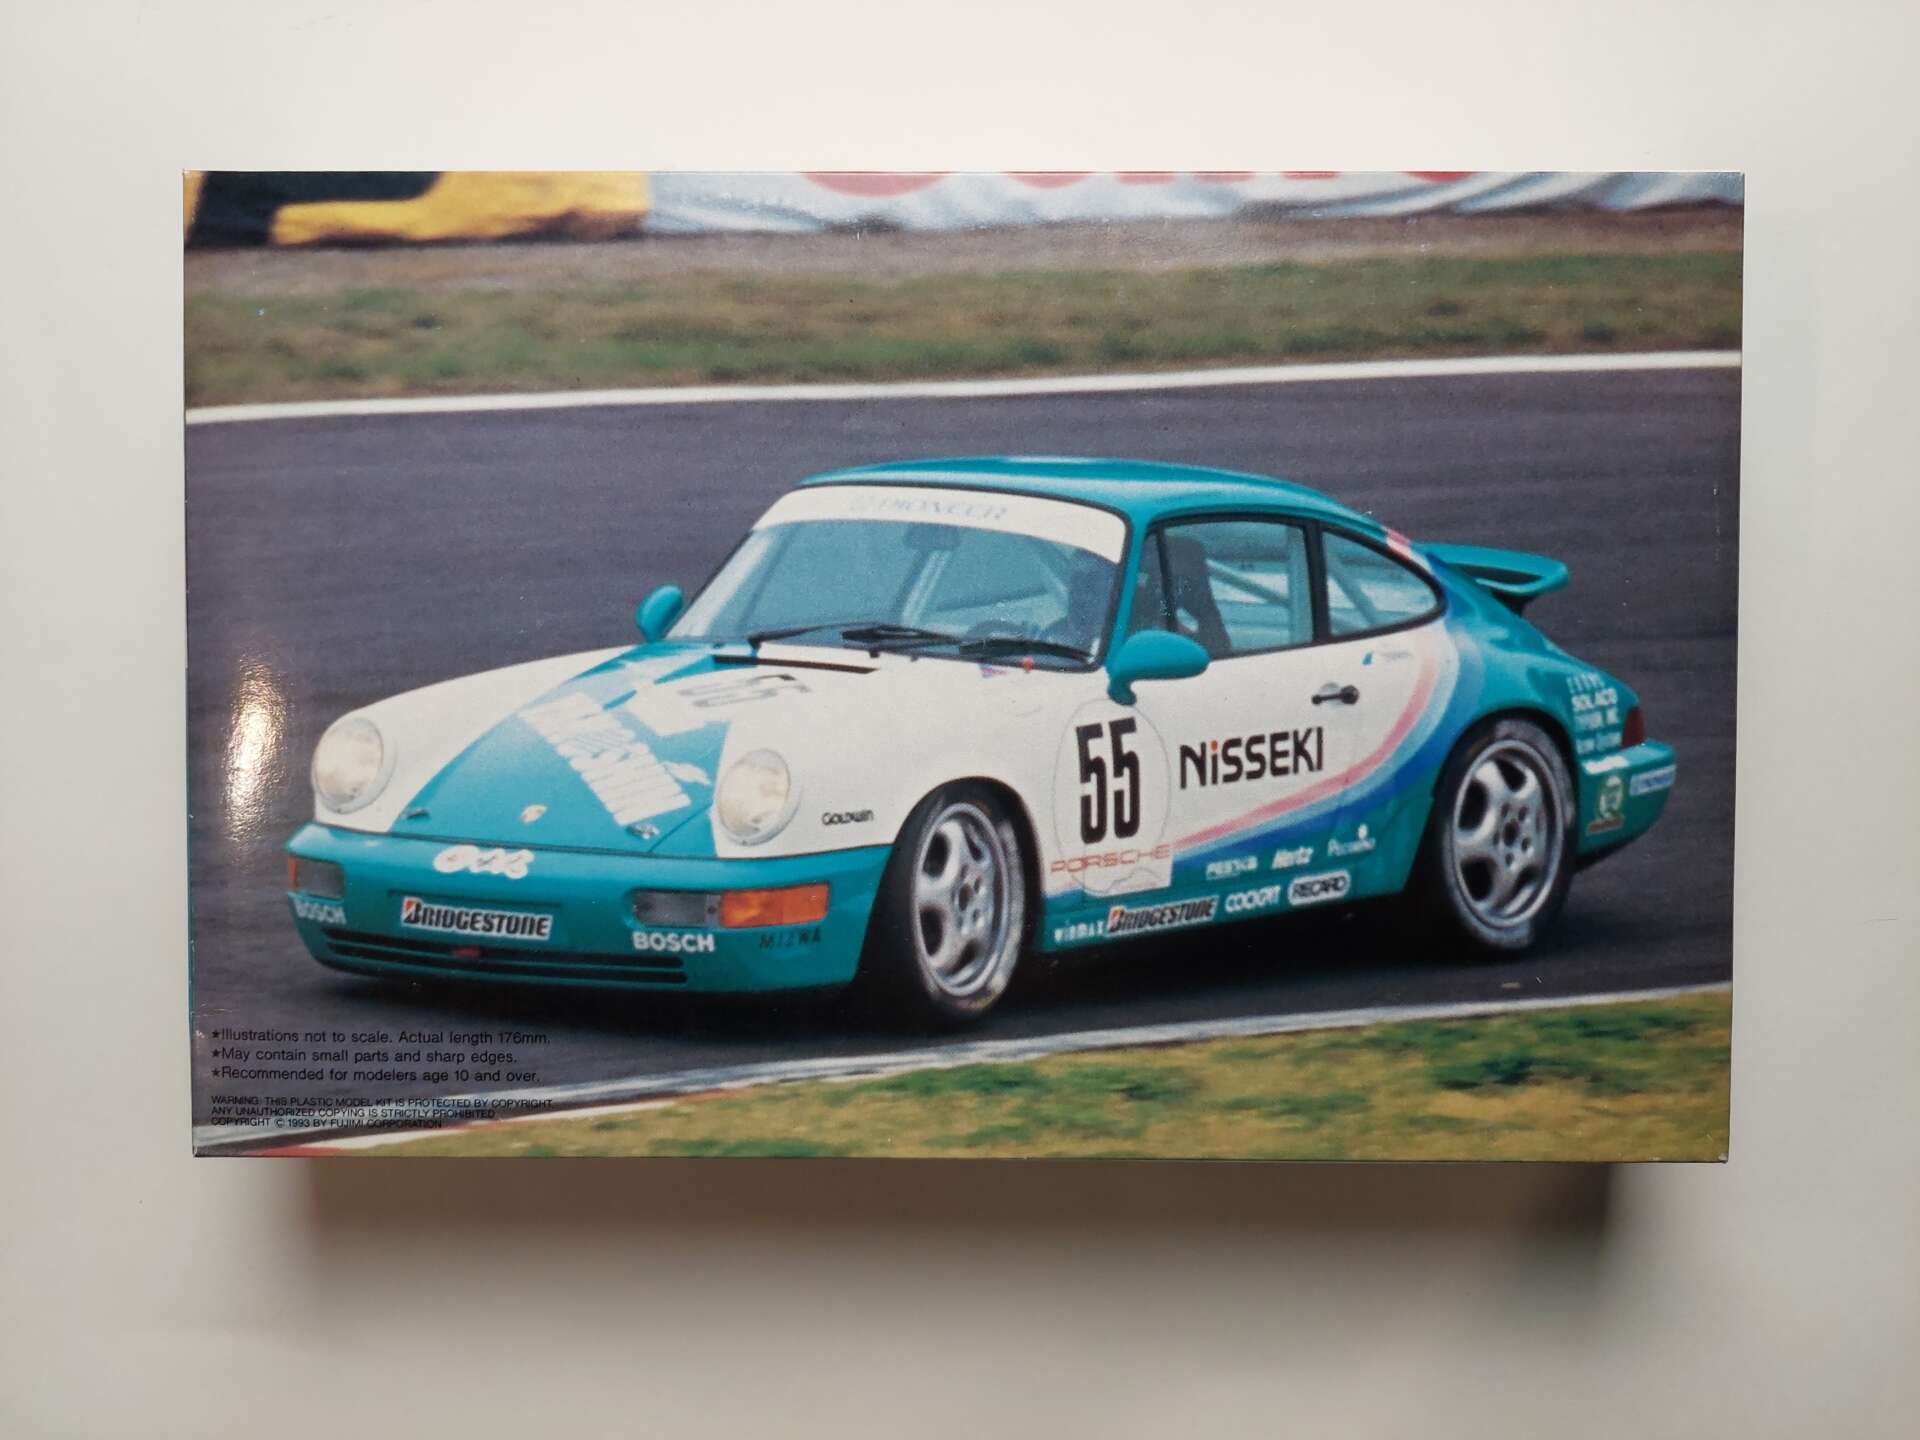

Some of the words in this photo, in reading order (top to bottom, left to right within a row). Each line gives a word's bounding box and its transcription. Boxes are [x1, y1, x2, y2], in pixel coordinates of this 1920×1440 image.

[1076, 716, 1141, 845] 55
[1051, 844, 1170, 873] PORSCHE
[295, 901, 347, 925] BOSCH
[403, 899, 550, 938] BRIDGESTONE
[1109, 898, 1217, 934] BRIDGESTONE
[632, 930, 715, 953] BOSCH
[304, 1031, 326, 1042] not
[332, 1031, 346, 1042] to
[351, 1030, 393, 1043] scale.
[398, 1031, 443, 1044] Actual
[449, 1031, 493, 1046] length
[499, 1031, 551, 1044] 176mm.
[221, 1048, 250, 1062] May
[255, 1049, 307, 1061] contain
[312, 1050, 349, 1062] small
[354, 1051, 389, 1064] parts
[394, 1050, 420, 1062] and
[426, 1050, 466, 1064] sharp
[471, 1051, 518, 1065] edges.
[221, 1066, 324, 1080] Recommended
[330, 1067, 348, 1080] for
[353, 1067, 417, 1081] modelers
[422, 1071, 449, 1083] age
[454, 1069, 469, 1081] 10
[474, 1069, 500, 1082] and
[506, 1071, 541, 1082] over.
[264, 1096, 288, 1106] THIS
[289, 1096, 332, 1106] PLASTIC
[335, 1097, 372, 1107] MODEL
[376, 1097, 393, 1107] KIT
[396, 1098, 405, 1107] IS
[407, 1098, 471, 1108] PROTECTED
[474, 1099, 488, 1108] BY
[211, 1106, 234, 1115] ANY
[235, 1106, 316, 1117] UNAUTHORIZED
[318, 1107, 365, 1118] COPYING
[368, 1108, 378, 1118] IS
[380, 1108, 430, 1118] STRICTLY
[432, 1109, 496, 1119] PROHIBITED
[211, 1117, 272, 1127] COPYRIGHT
[288, 1118, 310, 1128] 1993
[313, 1118, 327, 1128] BY
[330, 1119, 364, 1128] FUJIMI
[367, 1119, 442, 1129] CORPORATION
